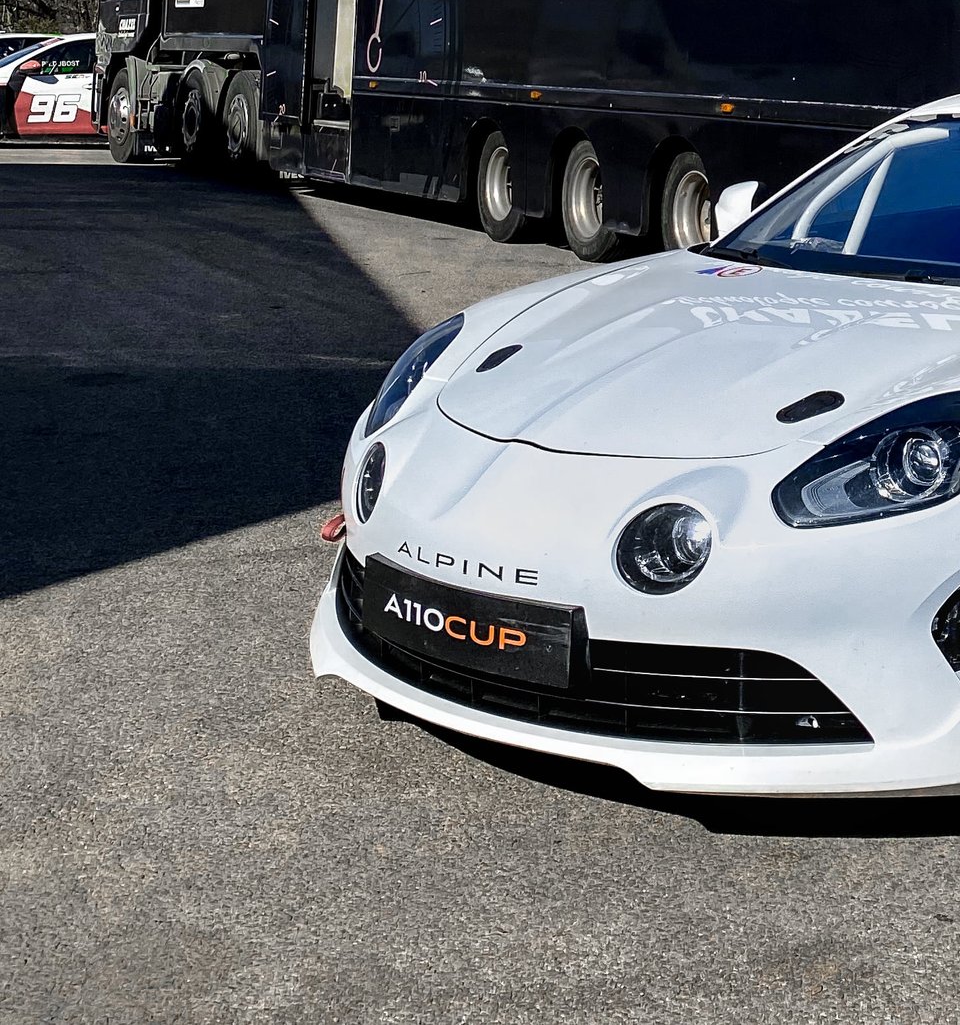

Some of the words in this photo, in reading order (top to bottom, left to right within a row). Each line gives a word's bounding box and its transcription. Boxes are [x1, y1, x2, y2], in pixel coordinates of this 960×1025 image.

[27, 93, 81, 123] 96
[398, 541, 539, 586] ALPINE
[384, 593, 527, 650] A110CUP
